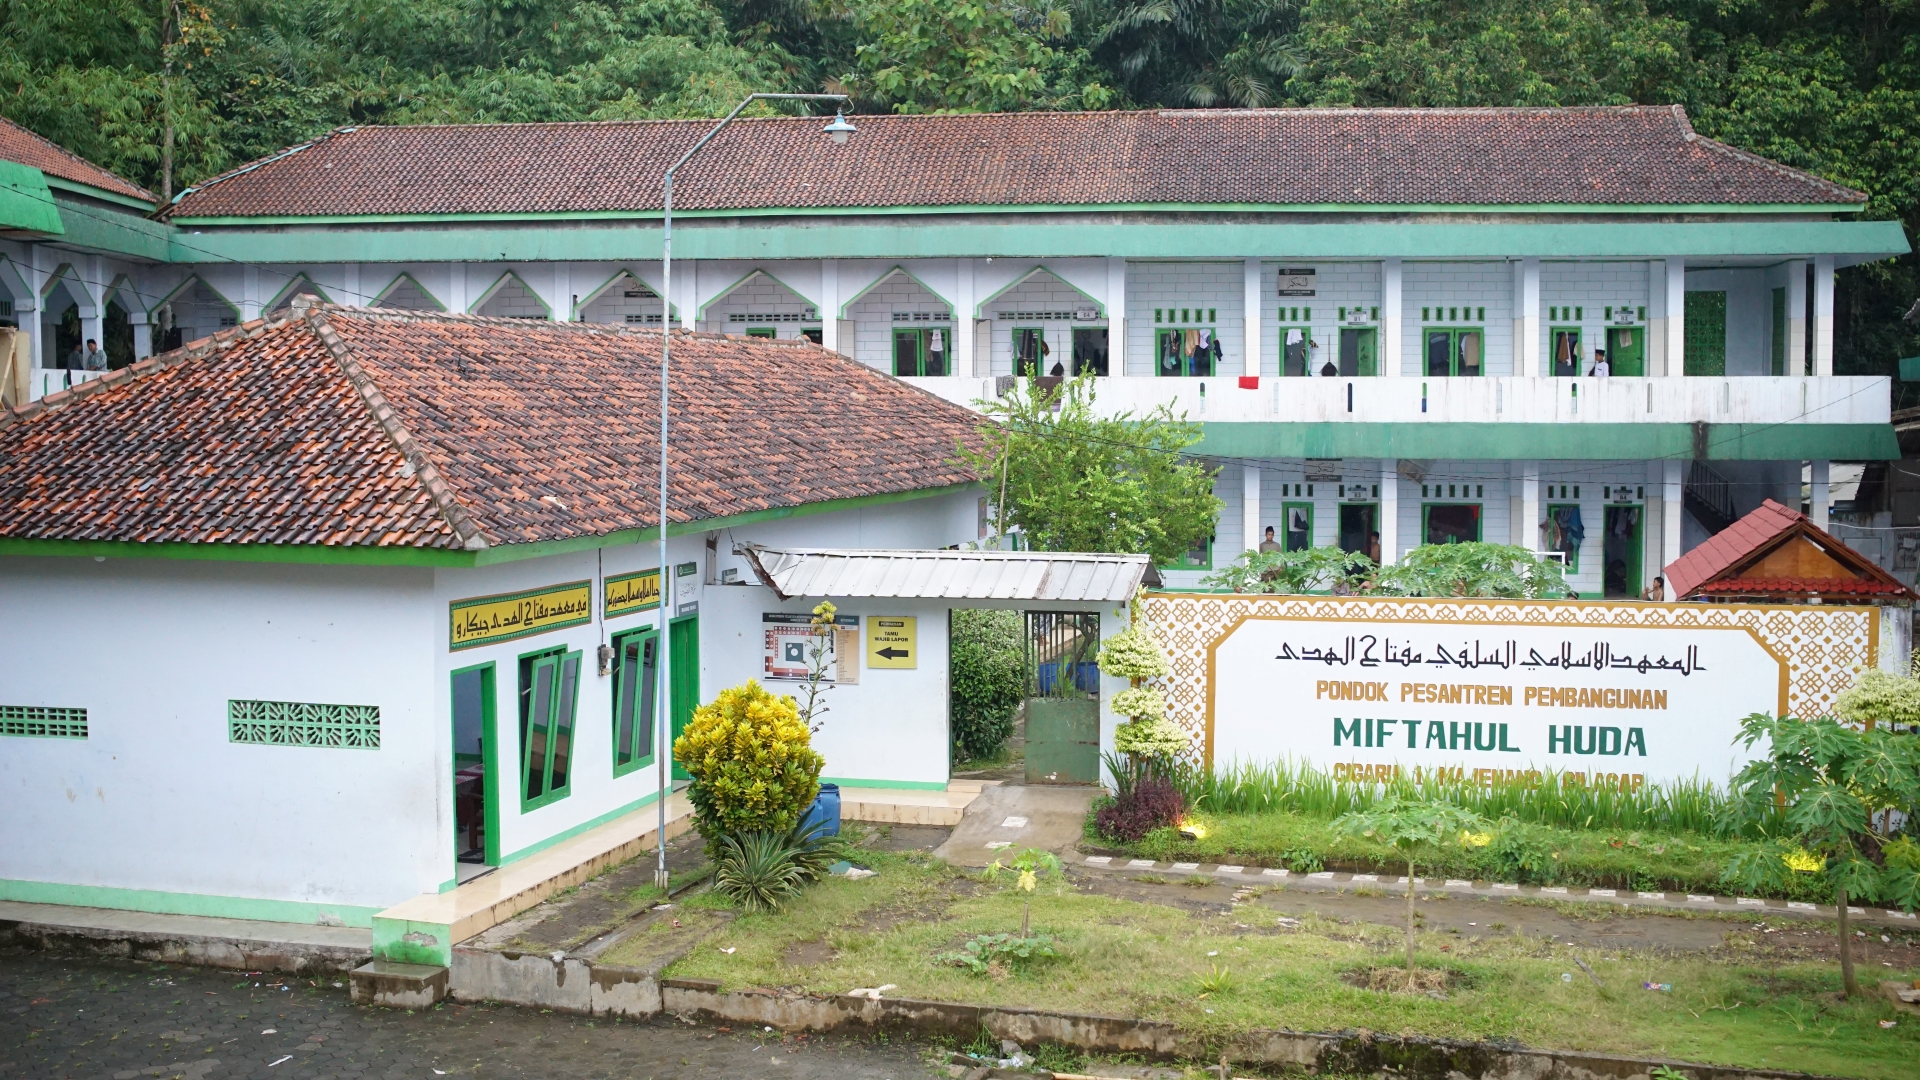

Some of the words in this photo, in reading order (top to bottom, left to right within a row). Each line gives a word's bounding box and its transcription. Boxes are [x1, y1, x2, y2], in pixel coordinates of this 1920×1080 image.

[1316, 680, 1389, 702] PONDOK
[1401, 682, 1513, 706] PESANTREN
[1524, 686, 1668, 710] PEMBANGUNAN
[1333, 717, 1522, 752] MIFTAHUL
[1548, 724, 1648, 757] HUDA
